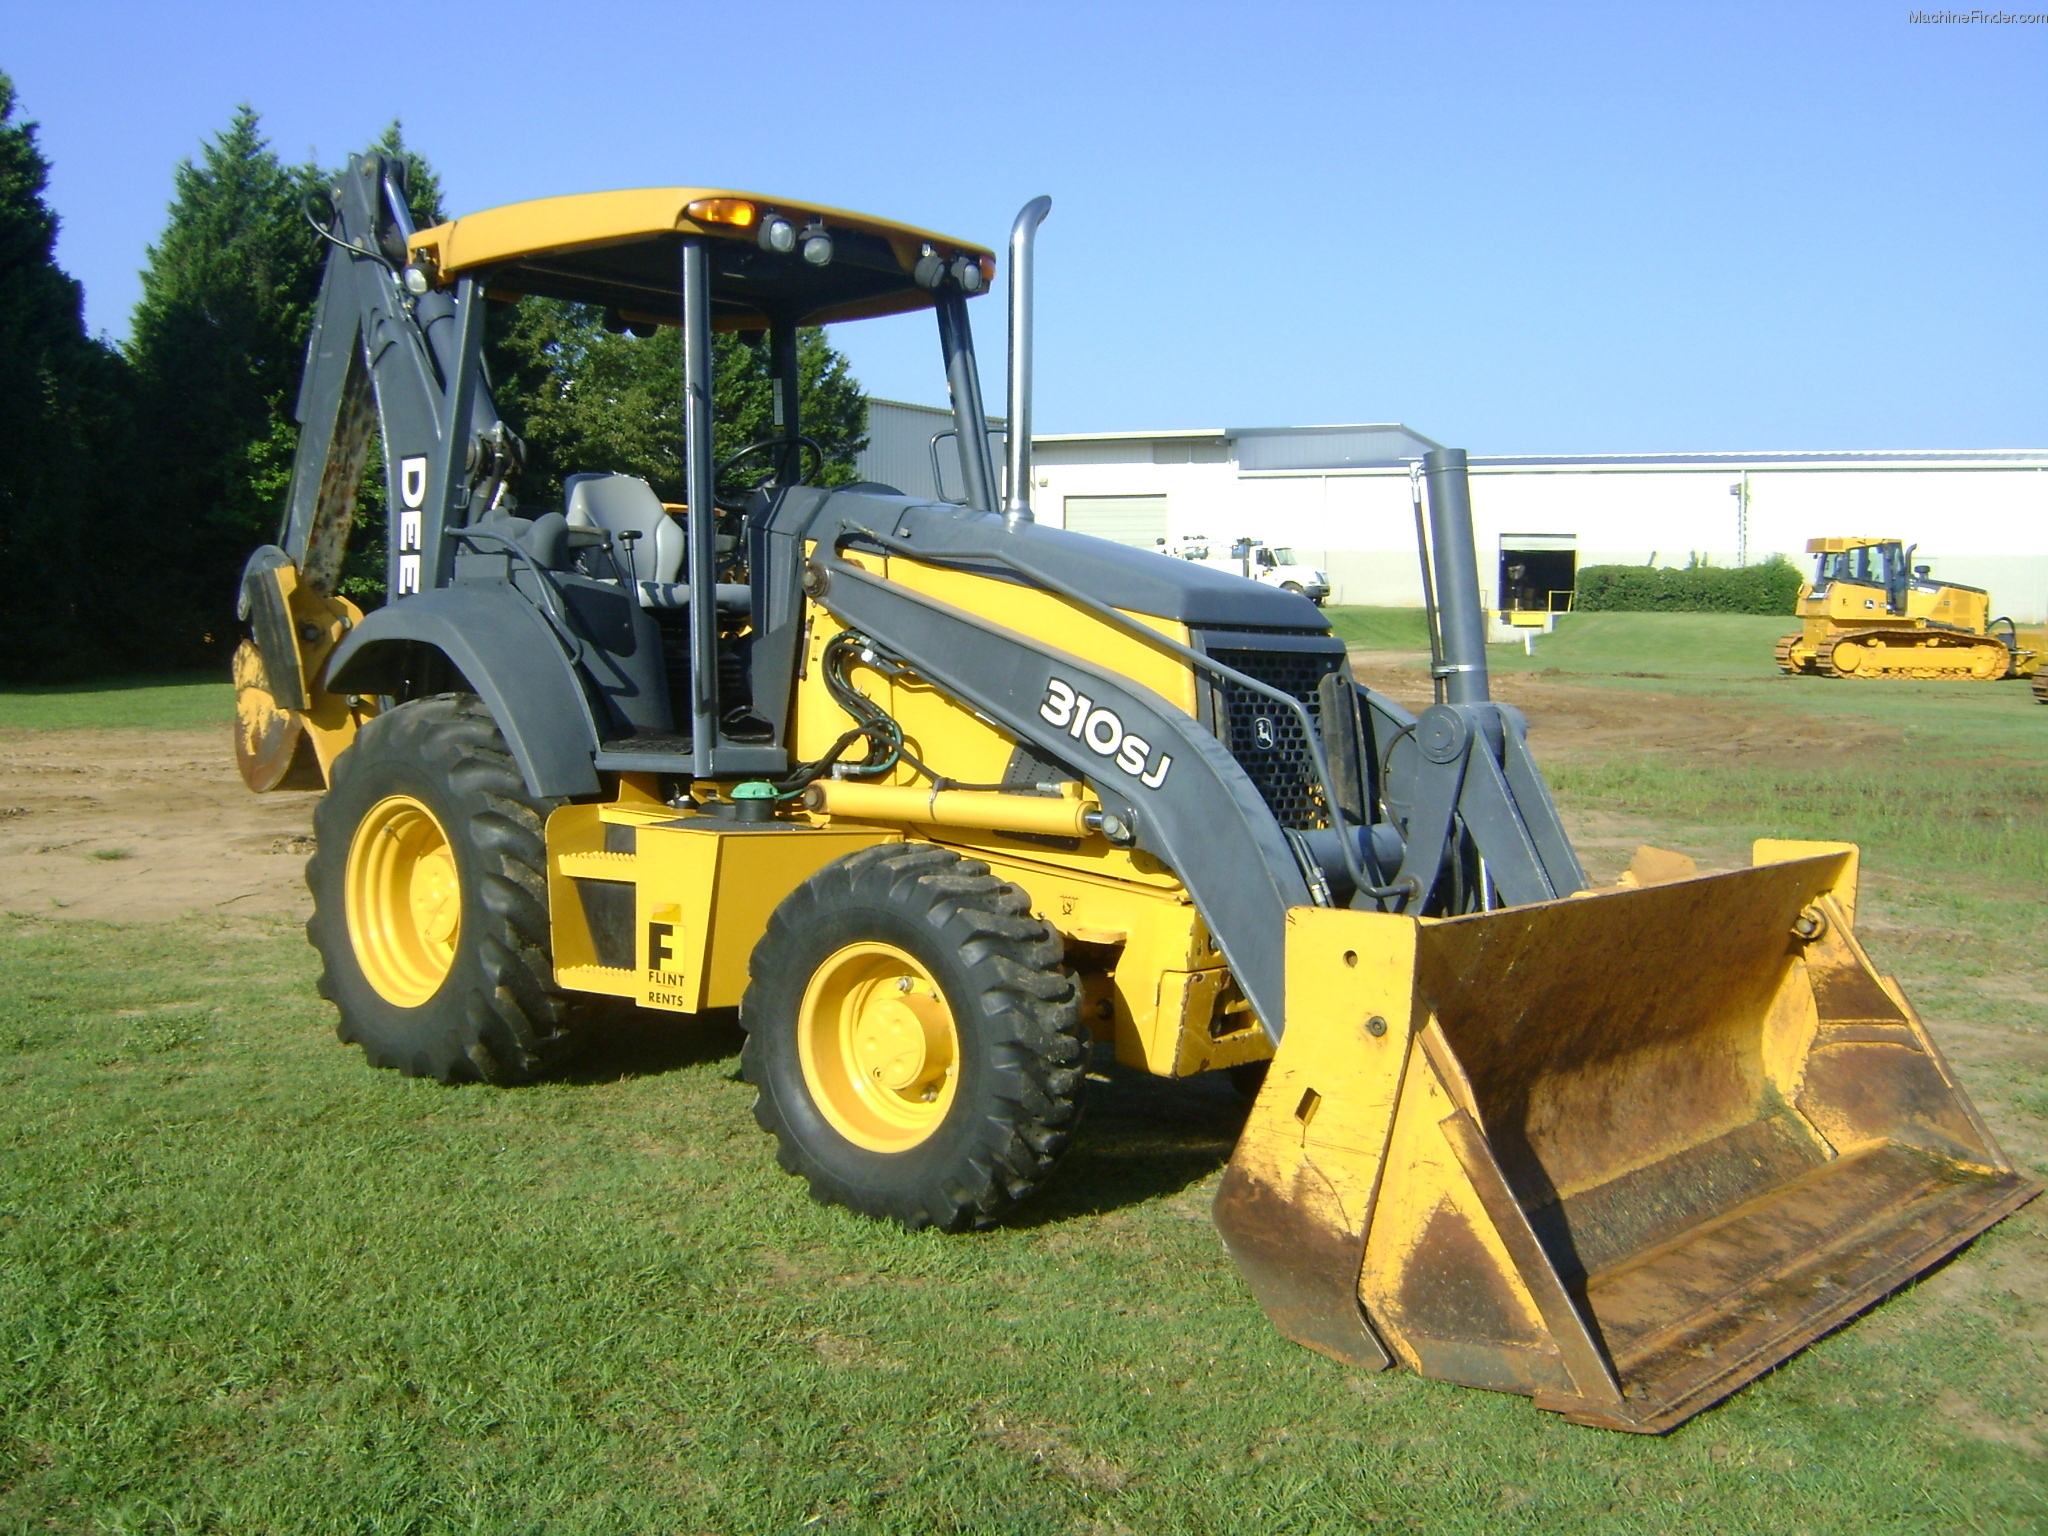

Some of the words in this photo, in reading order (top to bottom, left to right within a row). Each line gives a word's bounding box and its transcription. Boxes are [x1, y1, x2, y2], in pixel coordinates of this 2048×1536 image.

[1039, 677, 1173, 790] 310SJ
[648, 921, 674, 971] F
[648, 971, 685, 987] FLINT
[648, 991, 684, 1007] RENTS
